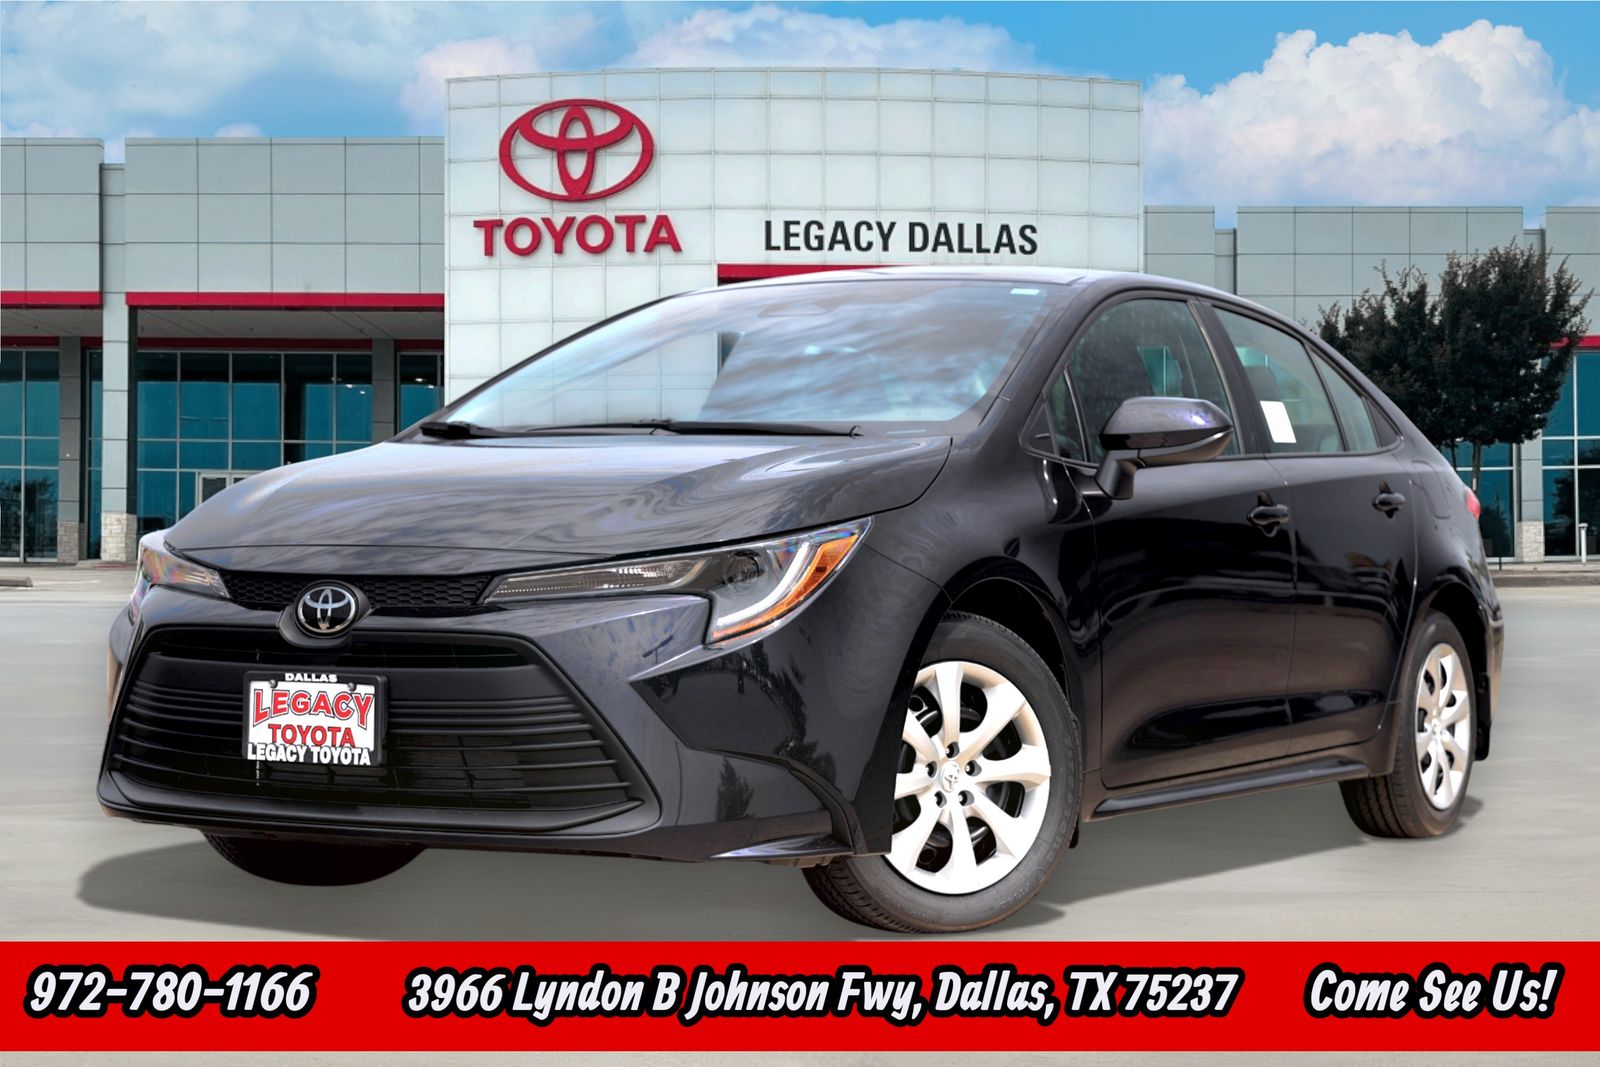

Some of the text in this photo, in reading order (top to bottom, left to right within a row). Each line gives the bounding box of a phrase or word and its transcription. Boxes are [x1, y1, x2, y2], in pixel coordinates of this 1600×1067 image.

[475, 215, 681, 256] TOYOTA
[765, 220, 1038, 255] LEGACY DALLAS
[284, 672, 338, 683] DALLAS
[253, 689, 375, 730] LEGACY
[268, 723, 356, 747] TOYOTA
[247, 742, 371, 765] LEGACY TOYOTA
